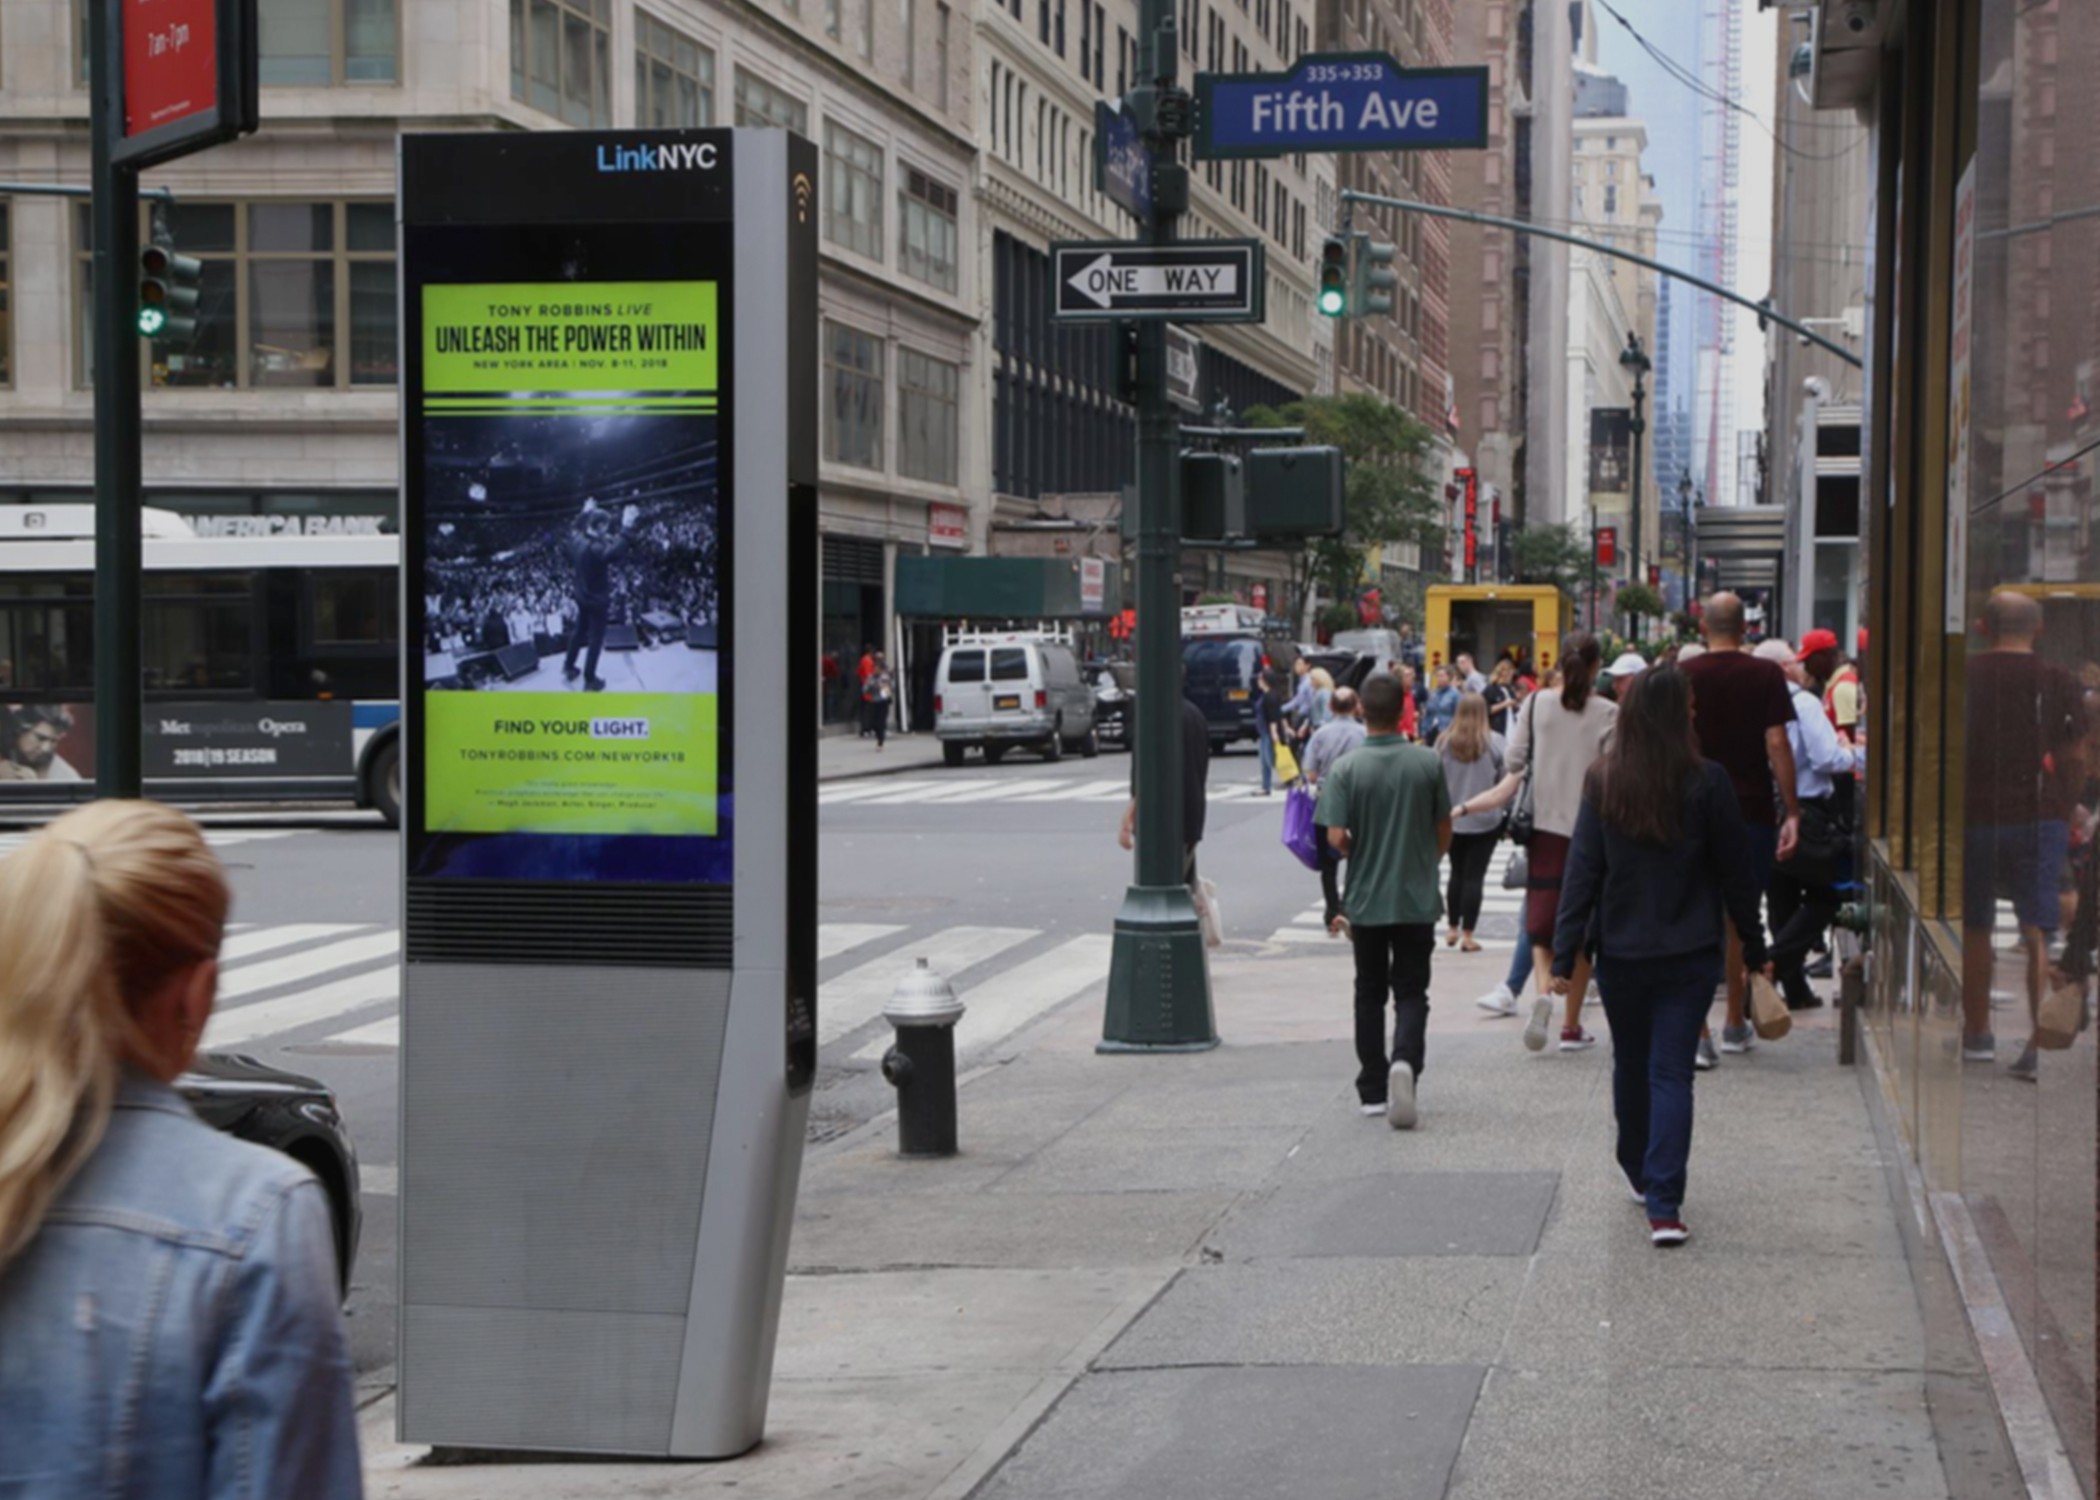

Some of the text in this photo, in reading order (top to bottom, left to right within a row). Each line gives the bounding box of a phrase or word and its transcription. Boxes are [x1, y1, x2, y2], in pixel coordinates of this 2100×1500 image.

[1307, 64, 1383, 82] 335 353
[1252, 90, 1439, 132] Fifth Ave
[597, 144, 717, 171] LinkNYC
[1088, 267, 1221, 293] ONE WAY
[488, 302, 654, 317] TONY ROBBINS LIVE
[435, 323, 707, 353] UNLEASH THE POWER WITHIN
[473, 360, 499, 370] NEW
[504, 360, 534, 369] YORK
[538, 360, 569, 369] AREA
[579, 359, 604, 369] NOV.
[641, 358, 668, 368] 2018
[304, 514, 387, 536] BANK
[258, 718, 307, 738] Opera
[494, 719, 648, 736] FIND YOUR LIGHT.
[226, 748, 277, 764] SEASON
[460, 748, 685, 763] TONYROBBINS.COM/NEWYORK18
